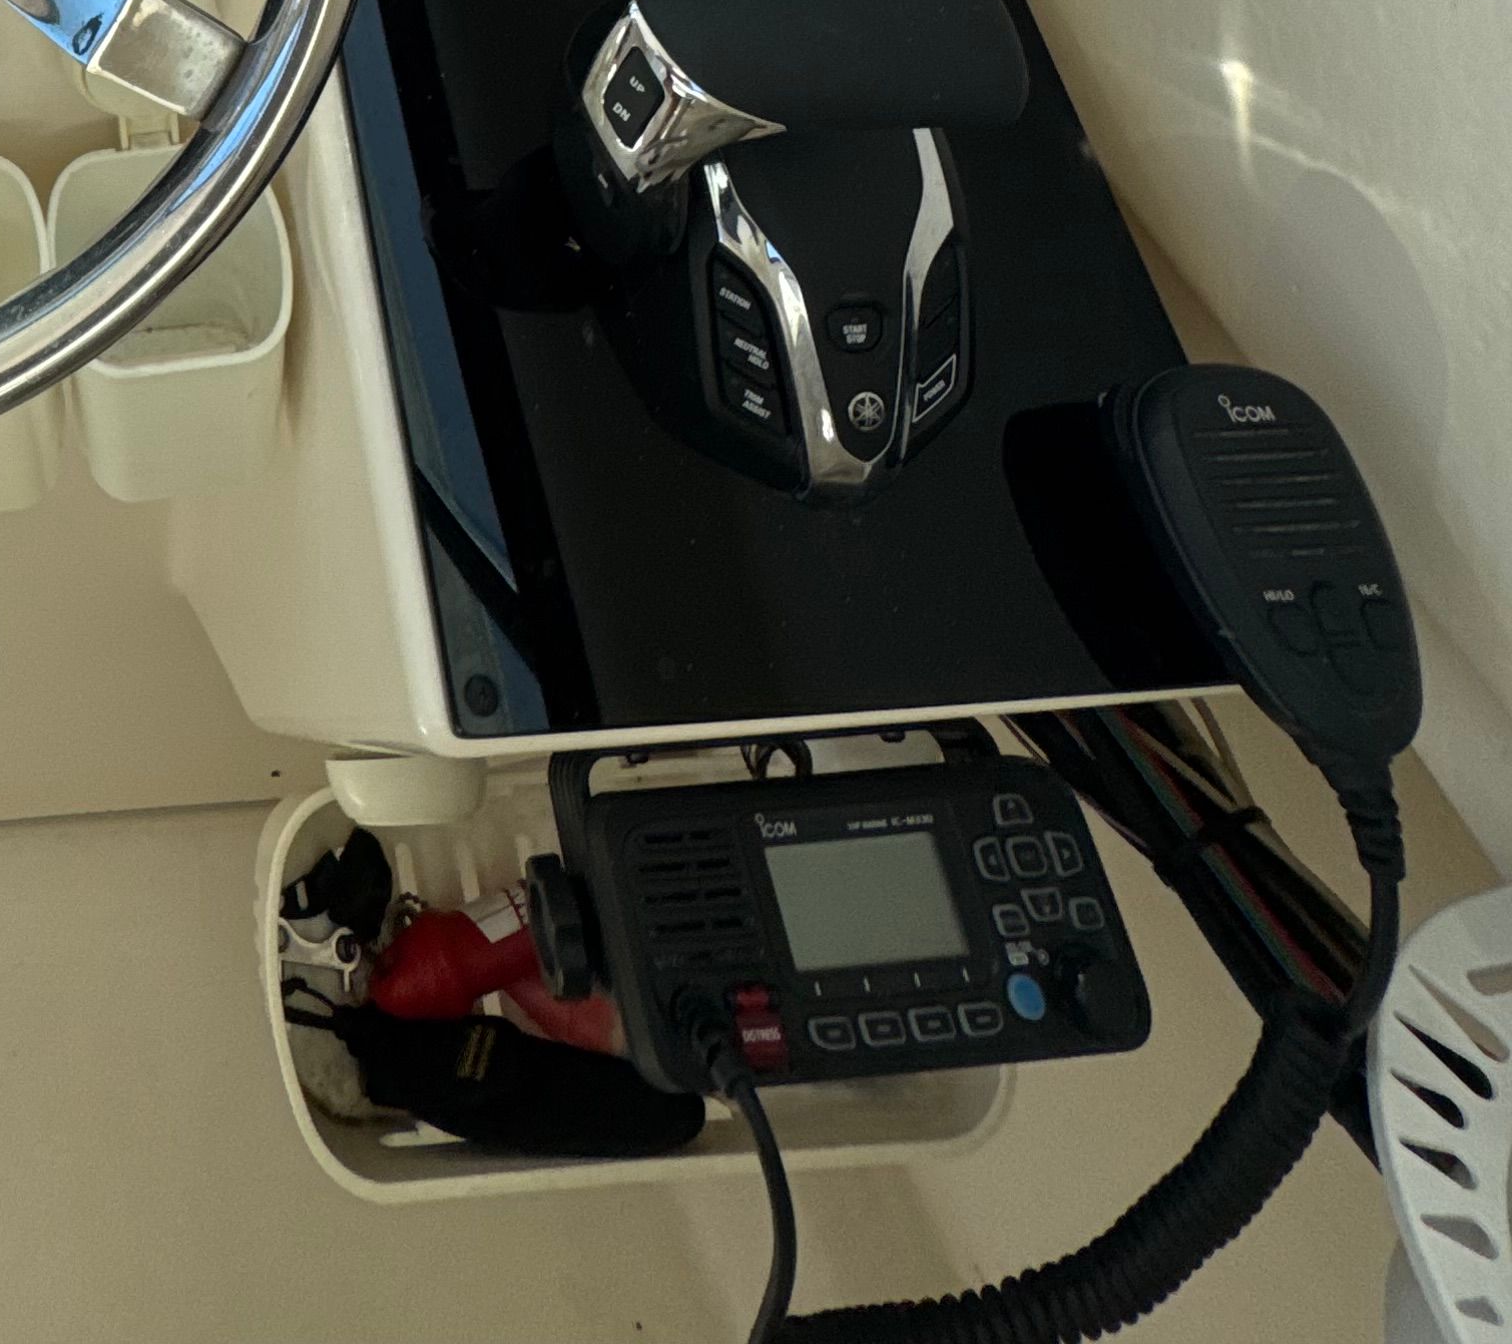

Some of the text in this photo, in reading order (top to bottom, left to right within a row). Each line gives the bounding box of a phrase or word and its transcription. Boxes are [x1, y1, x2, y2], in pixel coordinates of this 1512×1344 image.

[629, 75, 645, 92] UP
[612, 102, 631, 122] DN
[719, 287, 752, 310] STATION
[842, 323, 867, 335] START
[734, 337, 767, 359] NEUTRAL
[748, 355, 769, 370] HOLD
